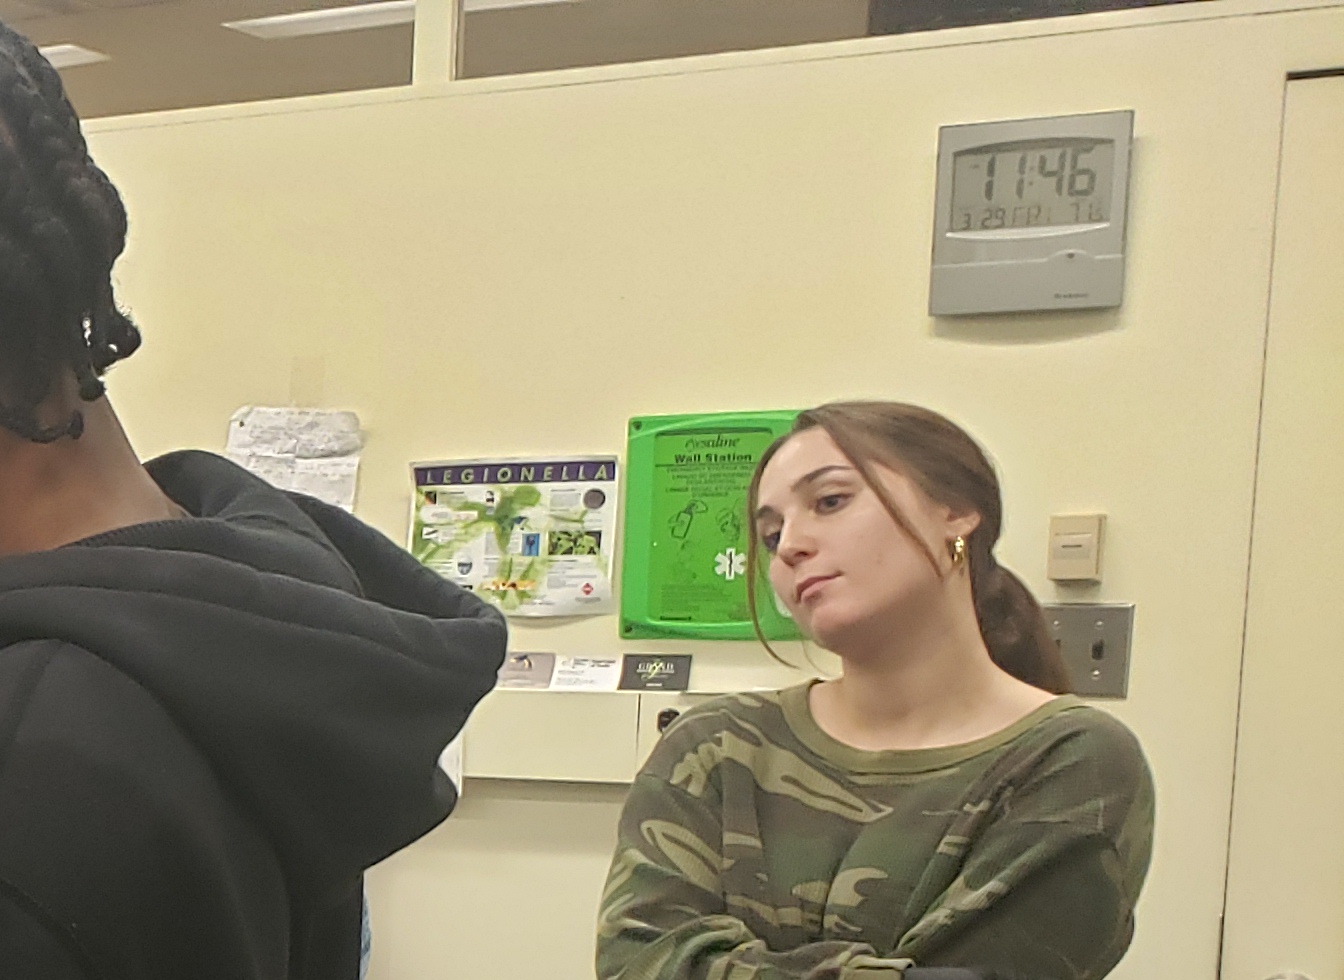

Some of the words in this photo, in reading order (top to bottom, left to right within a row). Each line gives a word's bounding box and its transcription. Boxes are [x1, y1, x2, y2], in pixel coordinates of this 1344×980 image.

[984, 146, 1097, 201] 11:46
[674, 453, 701, 464] Wall
[705, 453, 753, 463] Station
[425, 464, 609, 485] LEGIONELLA
